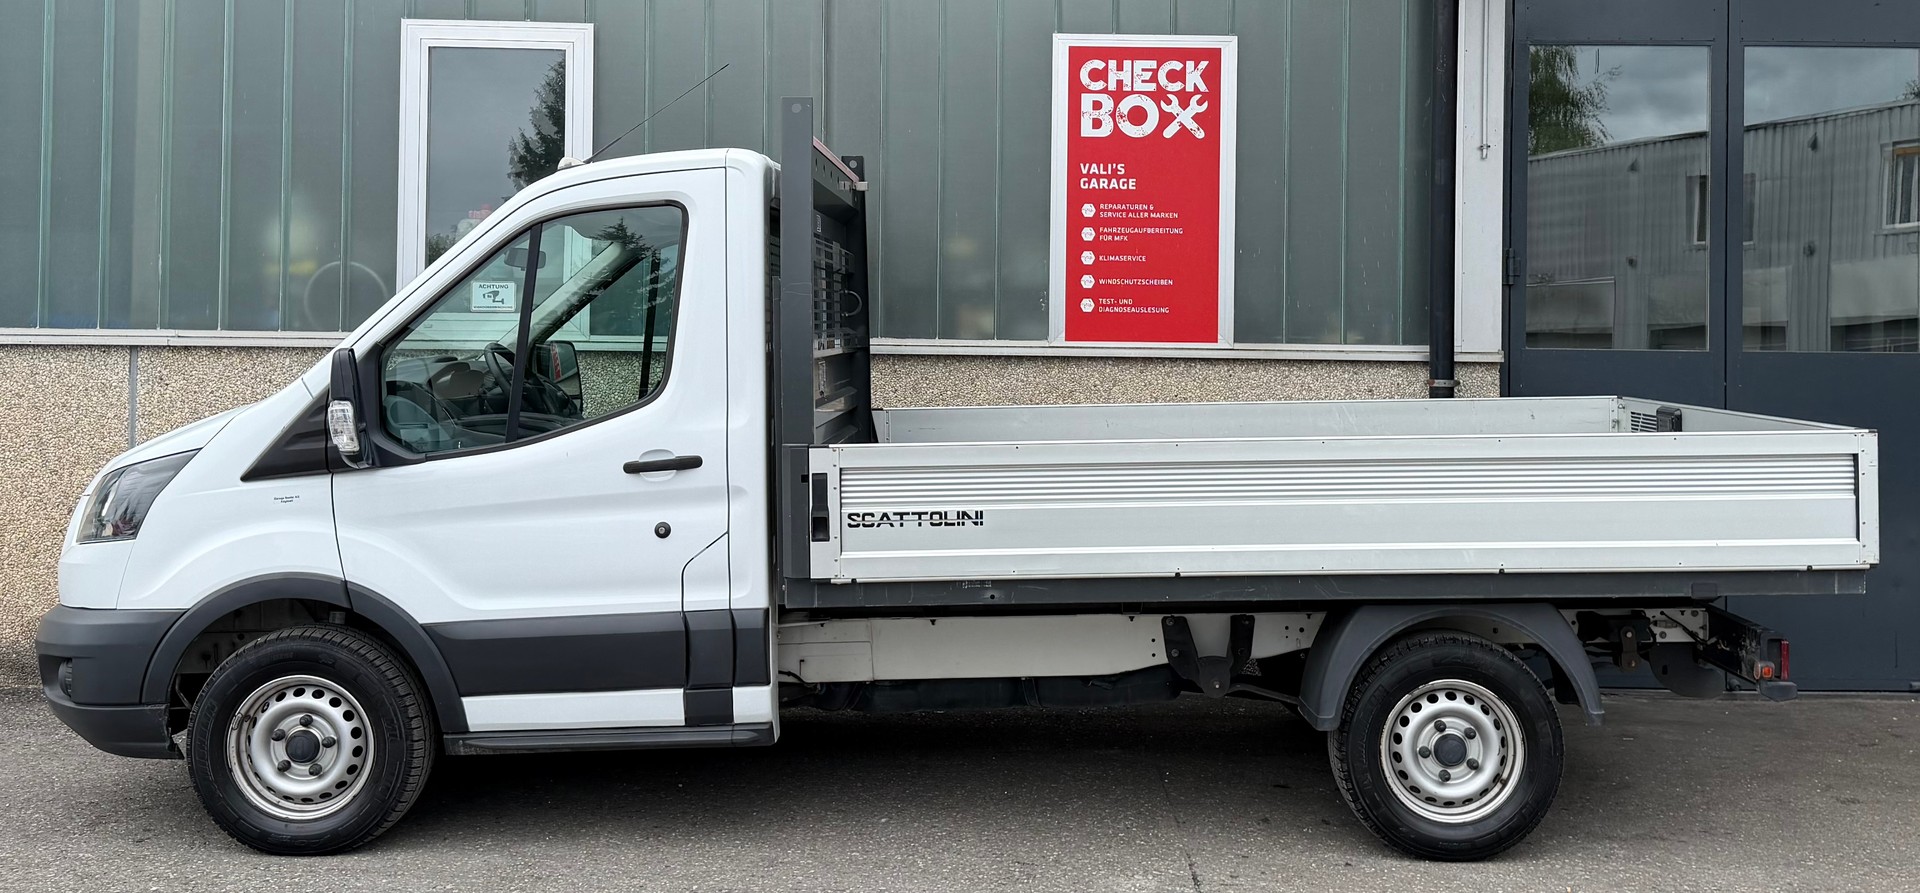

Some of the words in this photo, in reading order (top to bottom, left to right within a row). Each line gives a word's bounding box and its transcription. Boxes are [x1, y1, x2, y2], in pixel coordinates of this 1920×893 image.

[1080, 59, 1209, 92] CHECK
[1080, 93, 1209, 139] BOX
[1080, 163, 1125, 175] VALI'S
[1080, 178, 1136, 190] GARAGE
[1099, 278, 1173, 286] WINDSCHUTZSCHEIBEN
[1098, 306, 1170, 314] DIAGNOSEAUSLESUNG
[847, 510, 984, 528] SCATTOLINI
